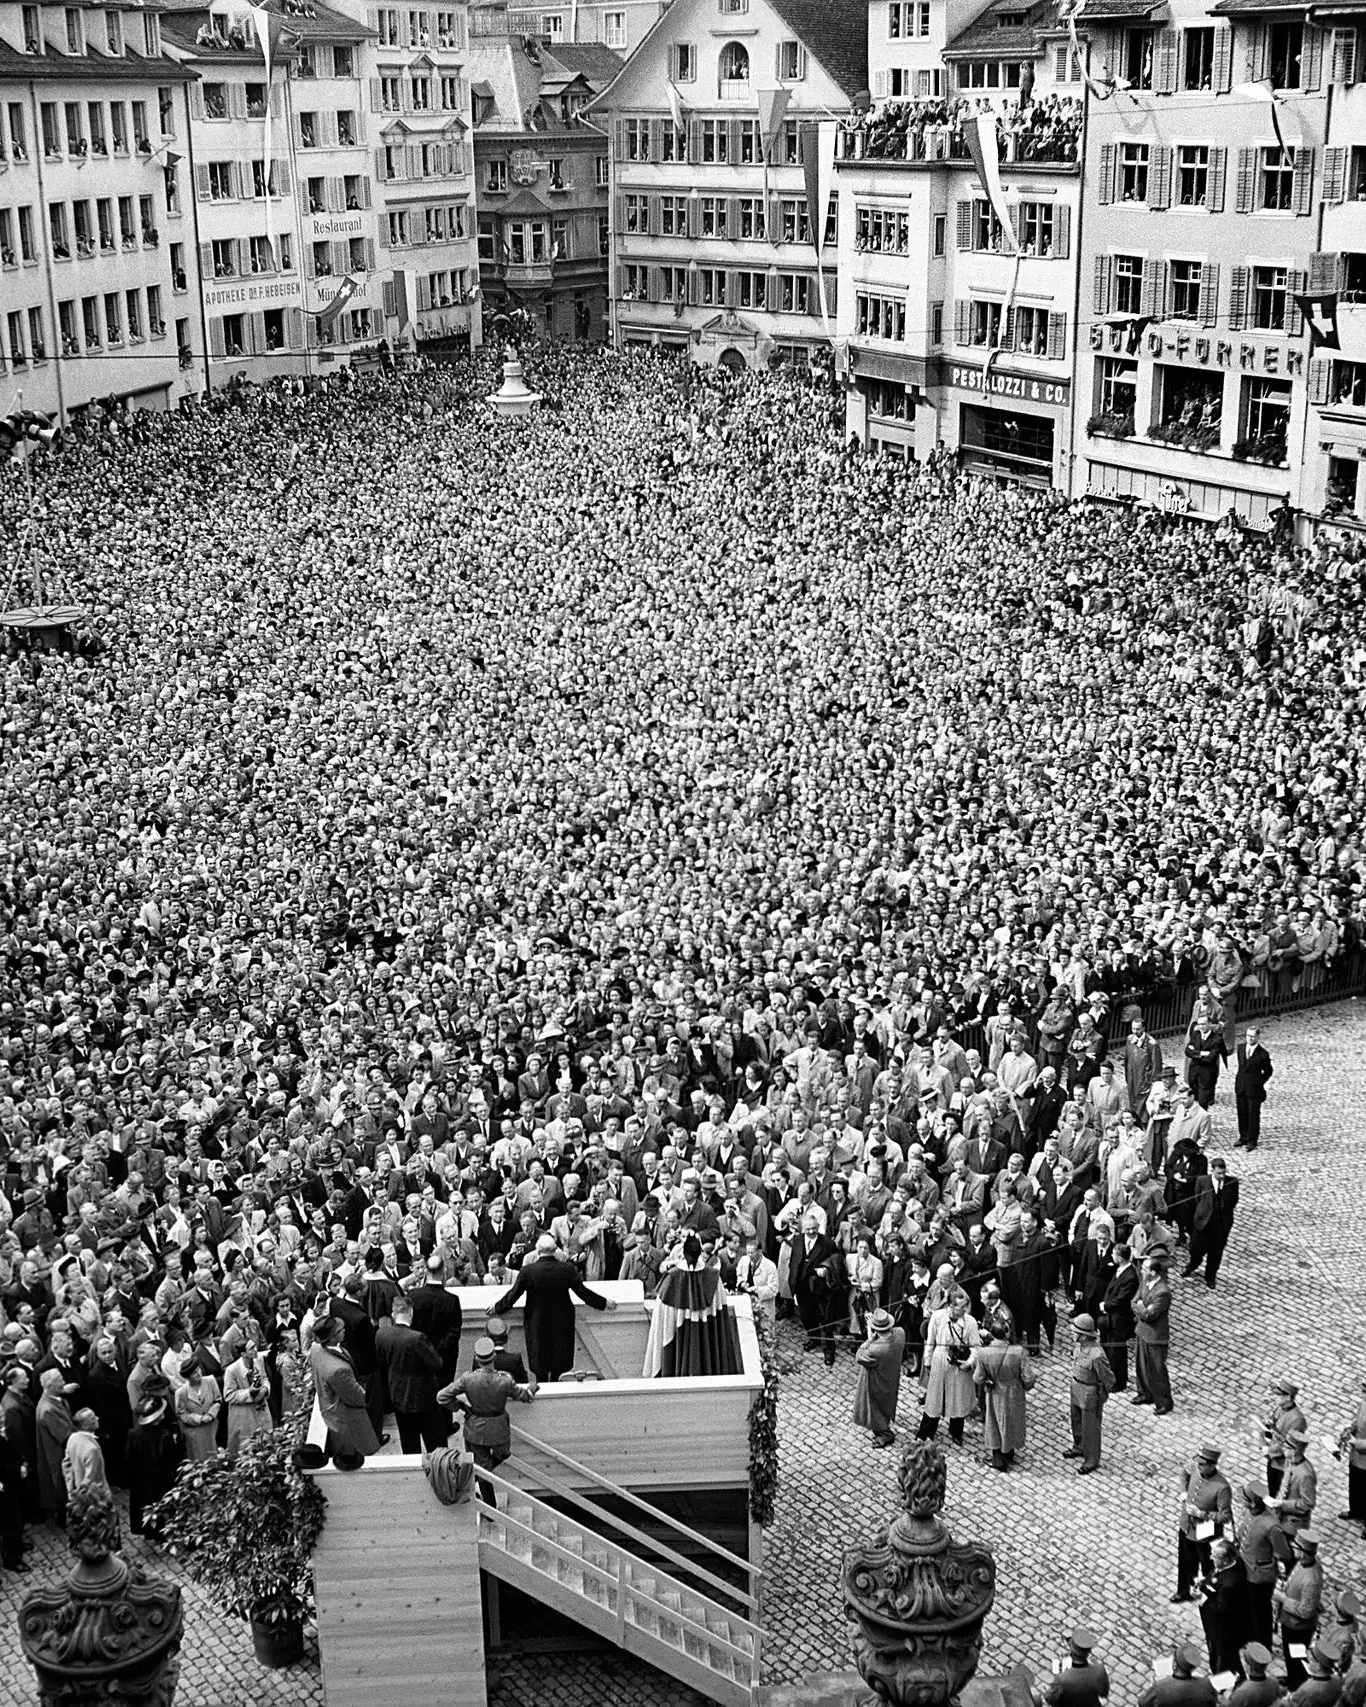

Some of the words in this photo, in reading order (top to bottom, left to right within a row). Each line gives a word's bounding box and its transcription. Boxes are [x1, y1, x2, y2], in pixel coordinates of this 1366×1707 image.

[313, 216, 363, 235] Restaurant
[205, 287, 246, 306] APOTHEKE
[952, 367, 1026, 397] PESTALOZZI
[1031, 381, 1040, 399] &
[1045, 383, 1067, 404] CO.
